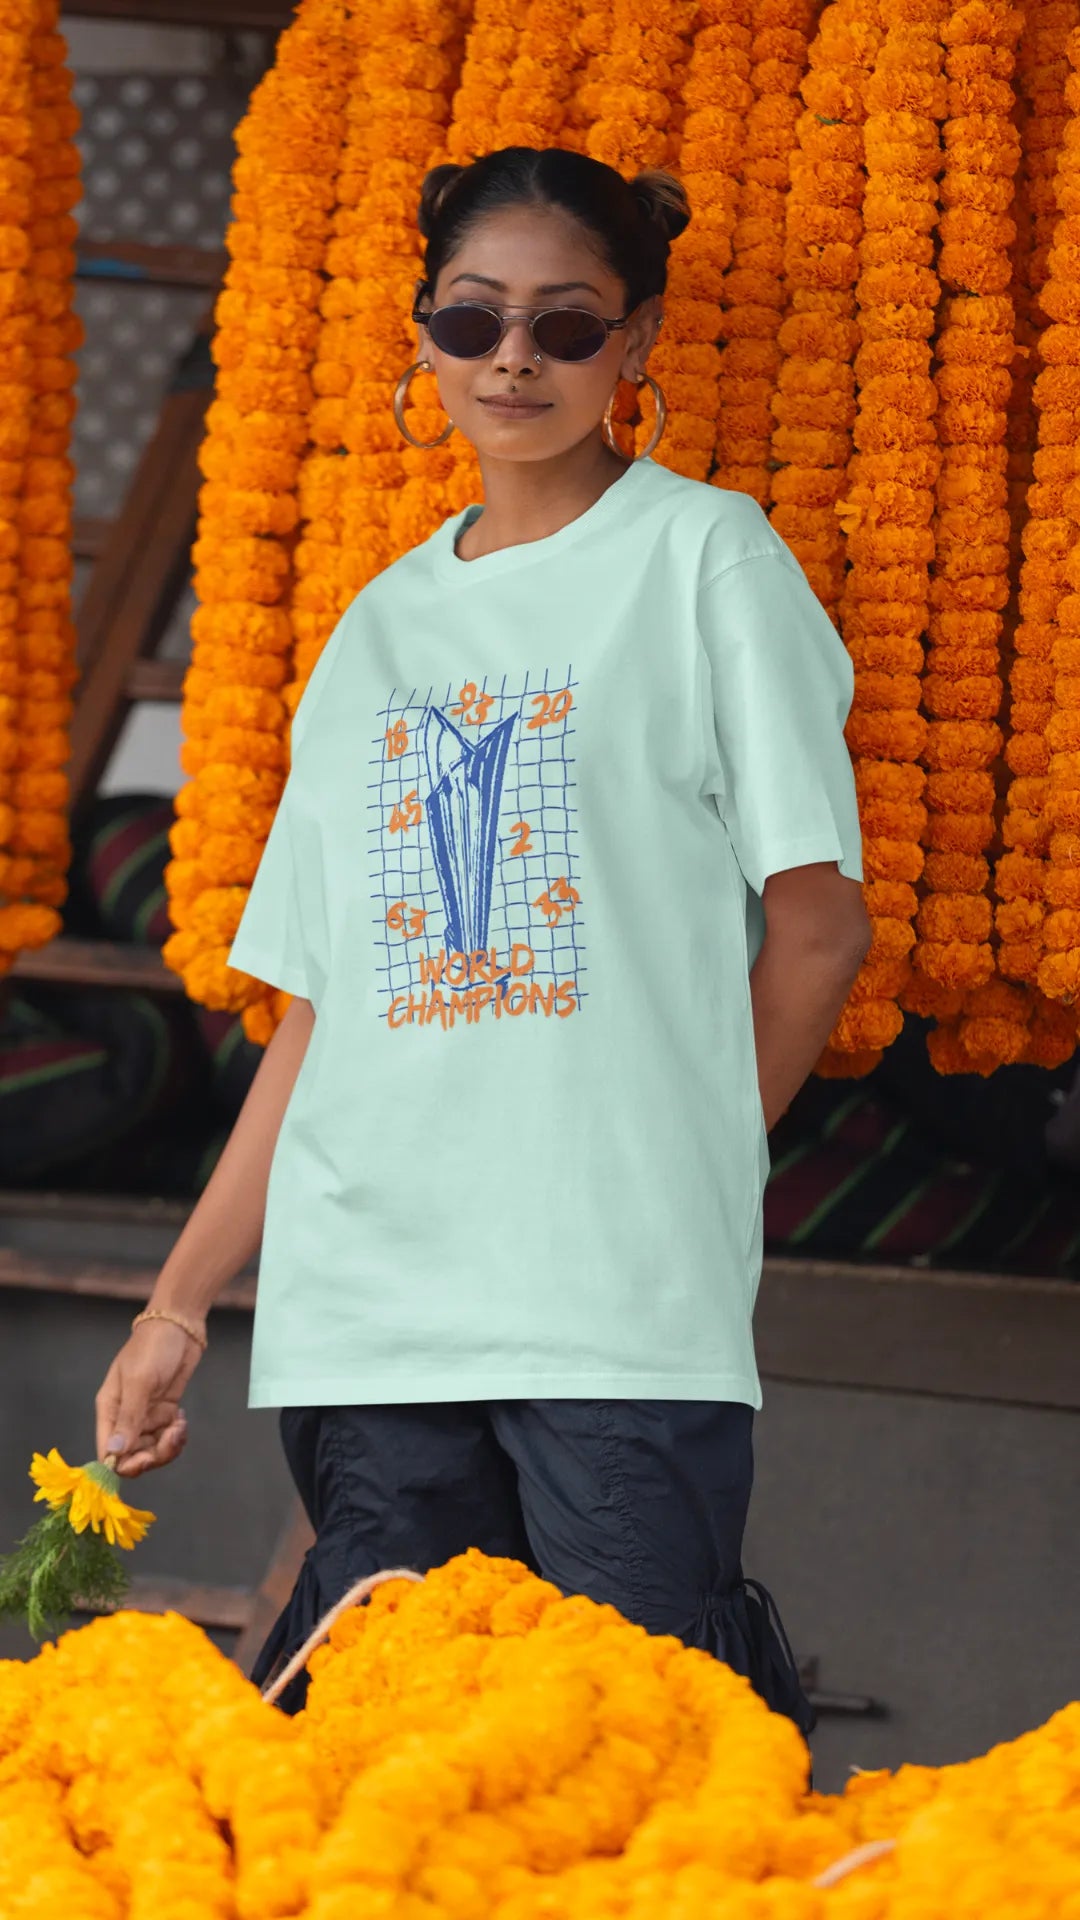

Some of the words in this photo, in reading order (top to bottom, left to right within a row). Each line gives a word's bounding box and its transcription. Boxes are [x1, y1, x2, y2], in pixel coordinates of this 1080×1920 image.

[450, 681, 496, 726] 93
[526, 689, 574, 731] 20
[384, 718, 410, 761] 18
[388, 789, 423, 835] 45
[509, 821, 533, 857] 2
[386, 901, 430, 939] 63
[531, 876, 581, 929] 33
[418, 943, 536, 986] WORLD
[387, 980, 578, 1031] CHAMPIONS
